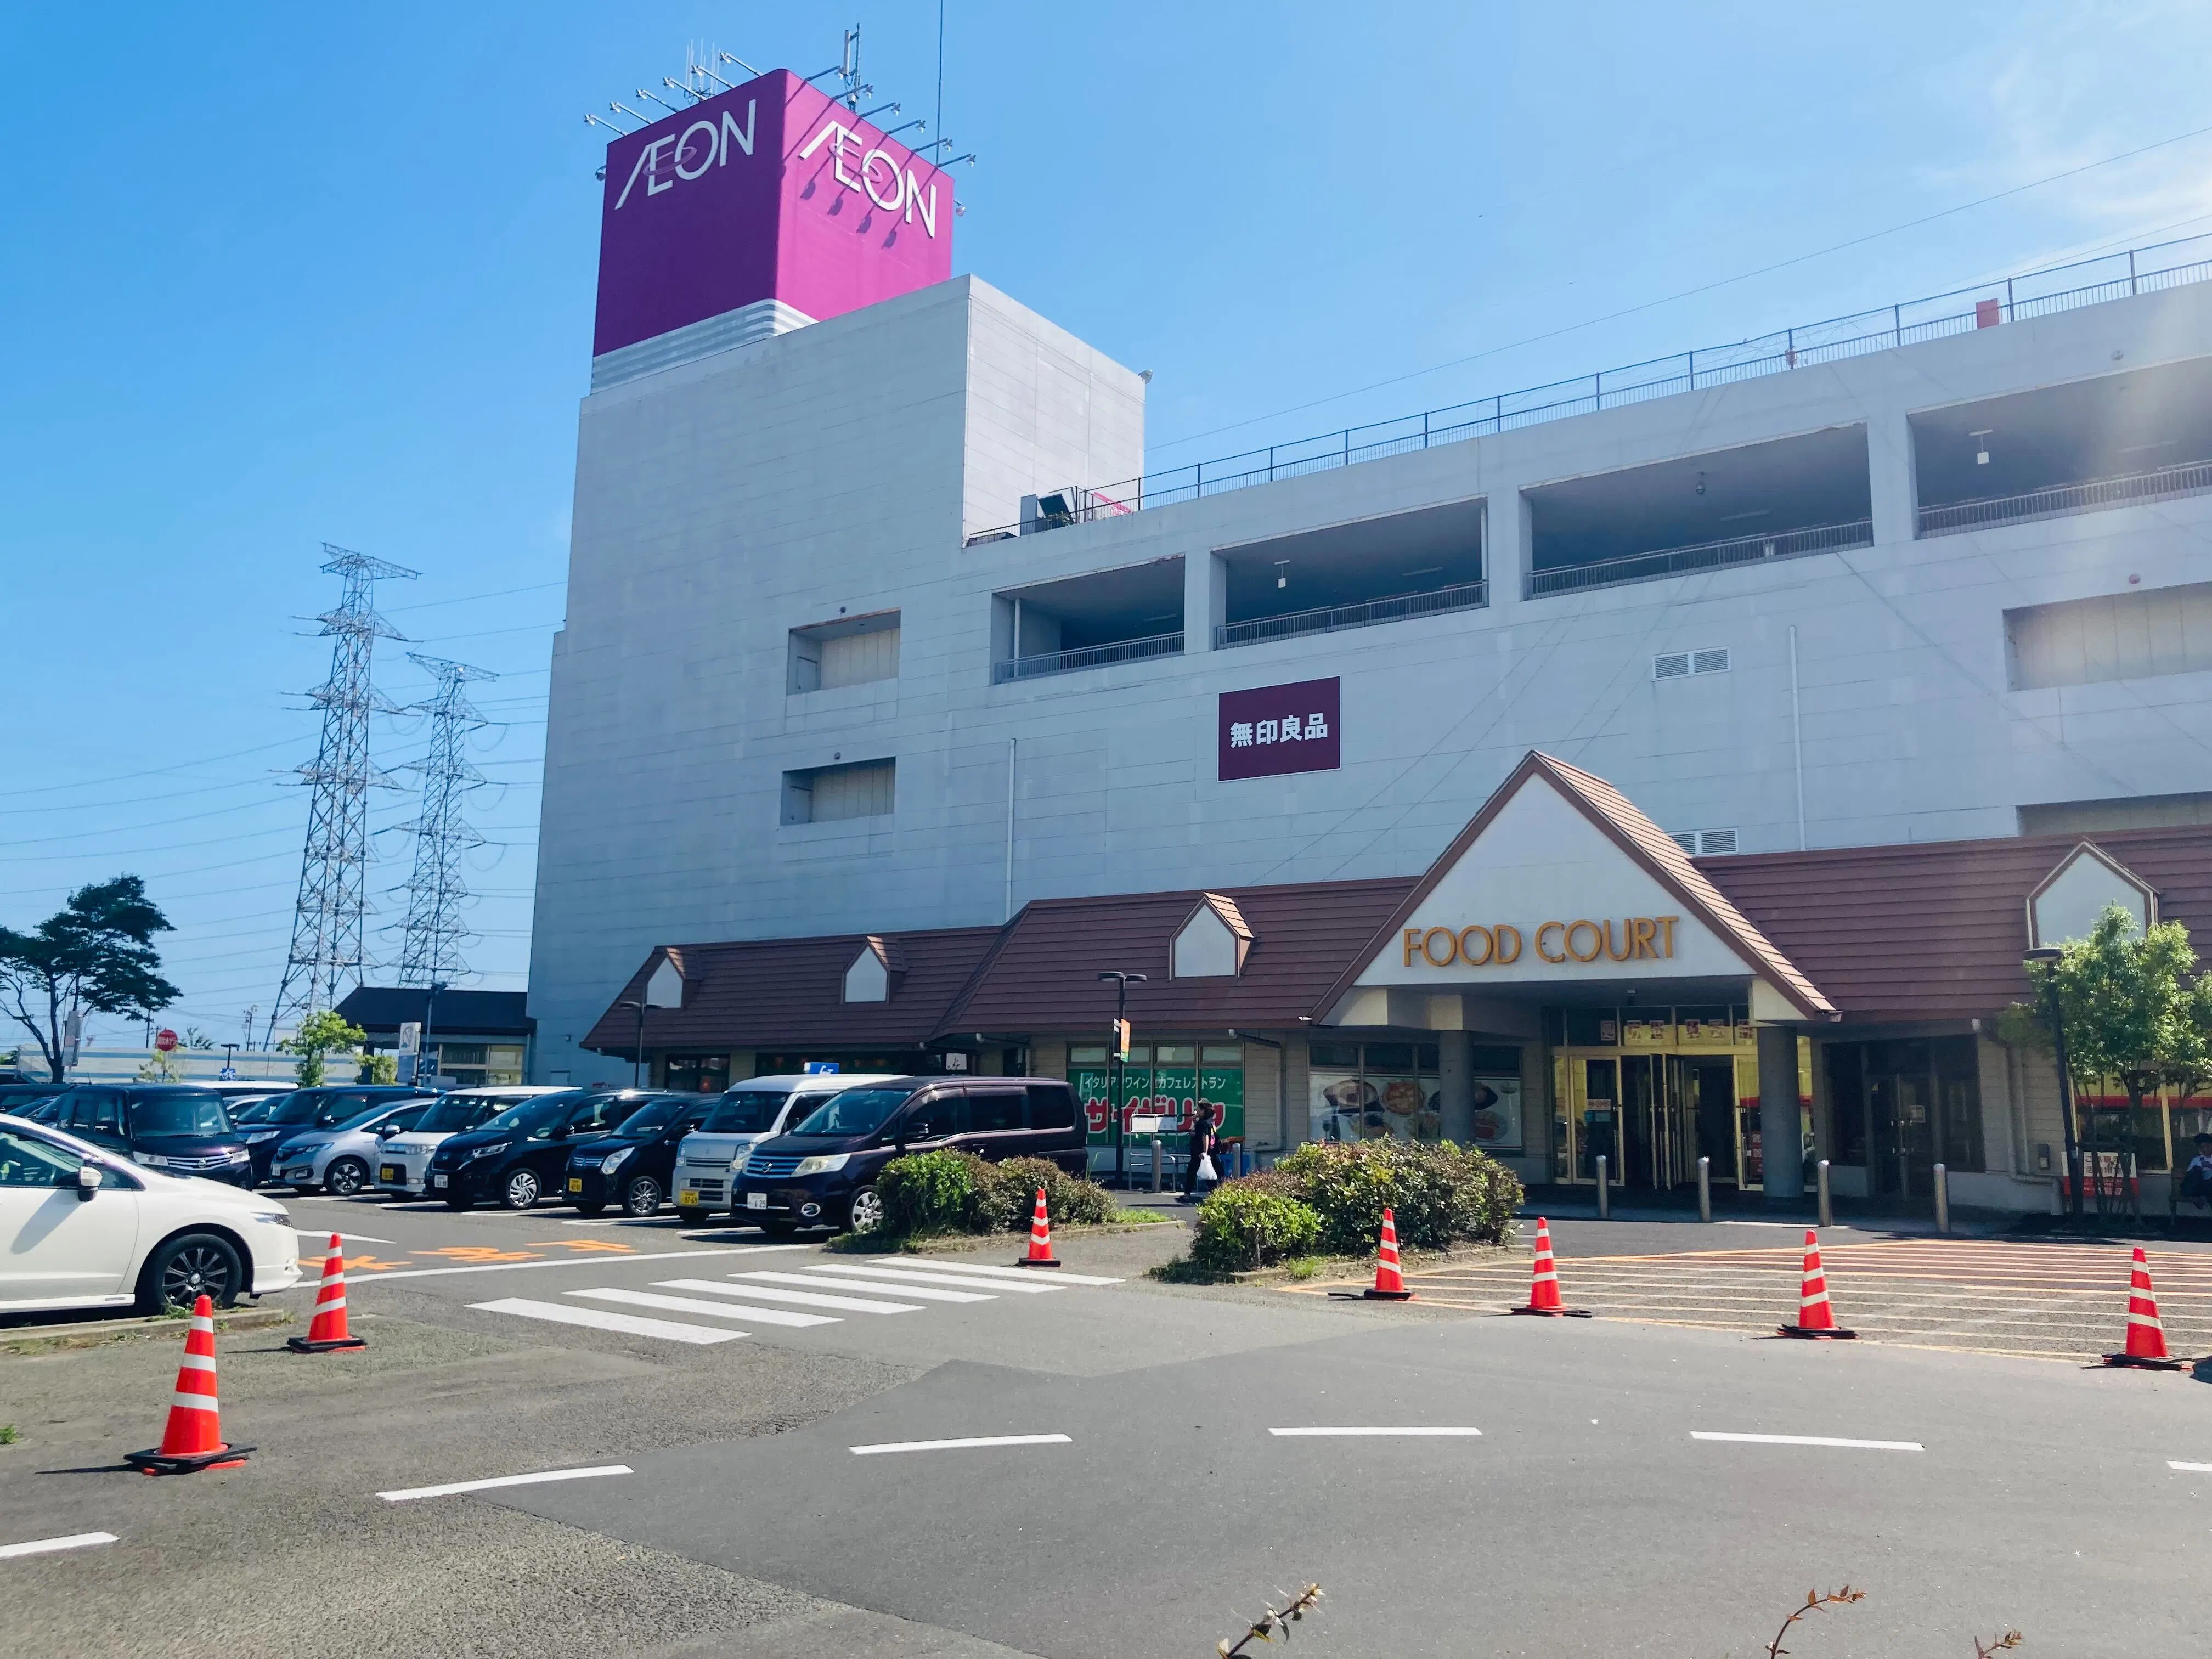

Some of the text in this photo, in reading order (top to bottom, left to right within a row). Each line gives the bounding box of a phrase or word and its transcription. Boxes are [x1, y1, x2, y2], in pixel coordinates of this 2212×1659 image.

[1229, 713, 1328, 749] 無印良品
[1403, 916, 1679, 967] FOOD COURT
